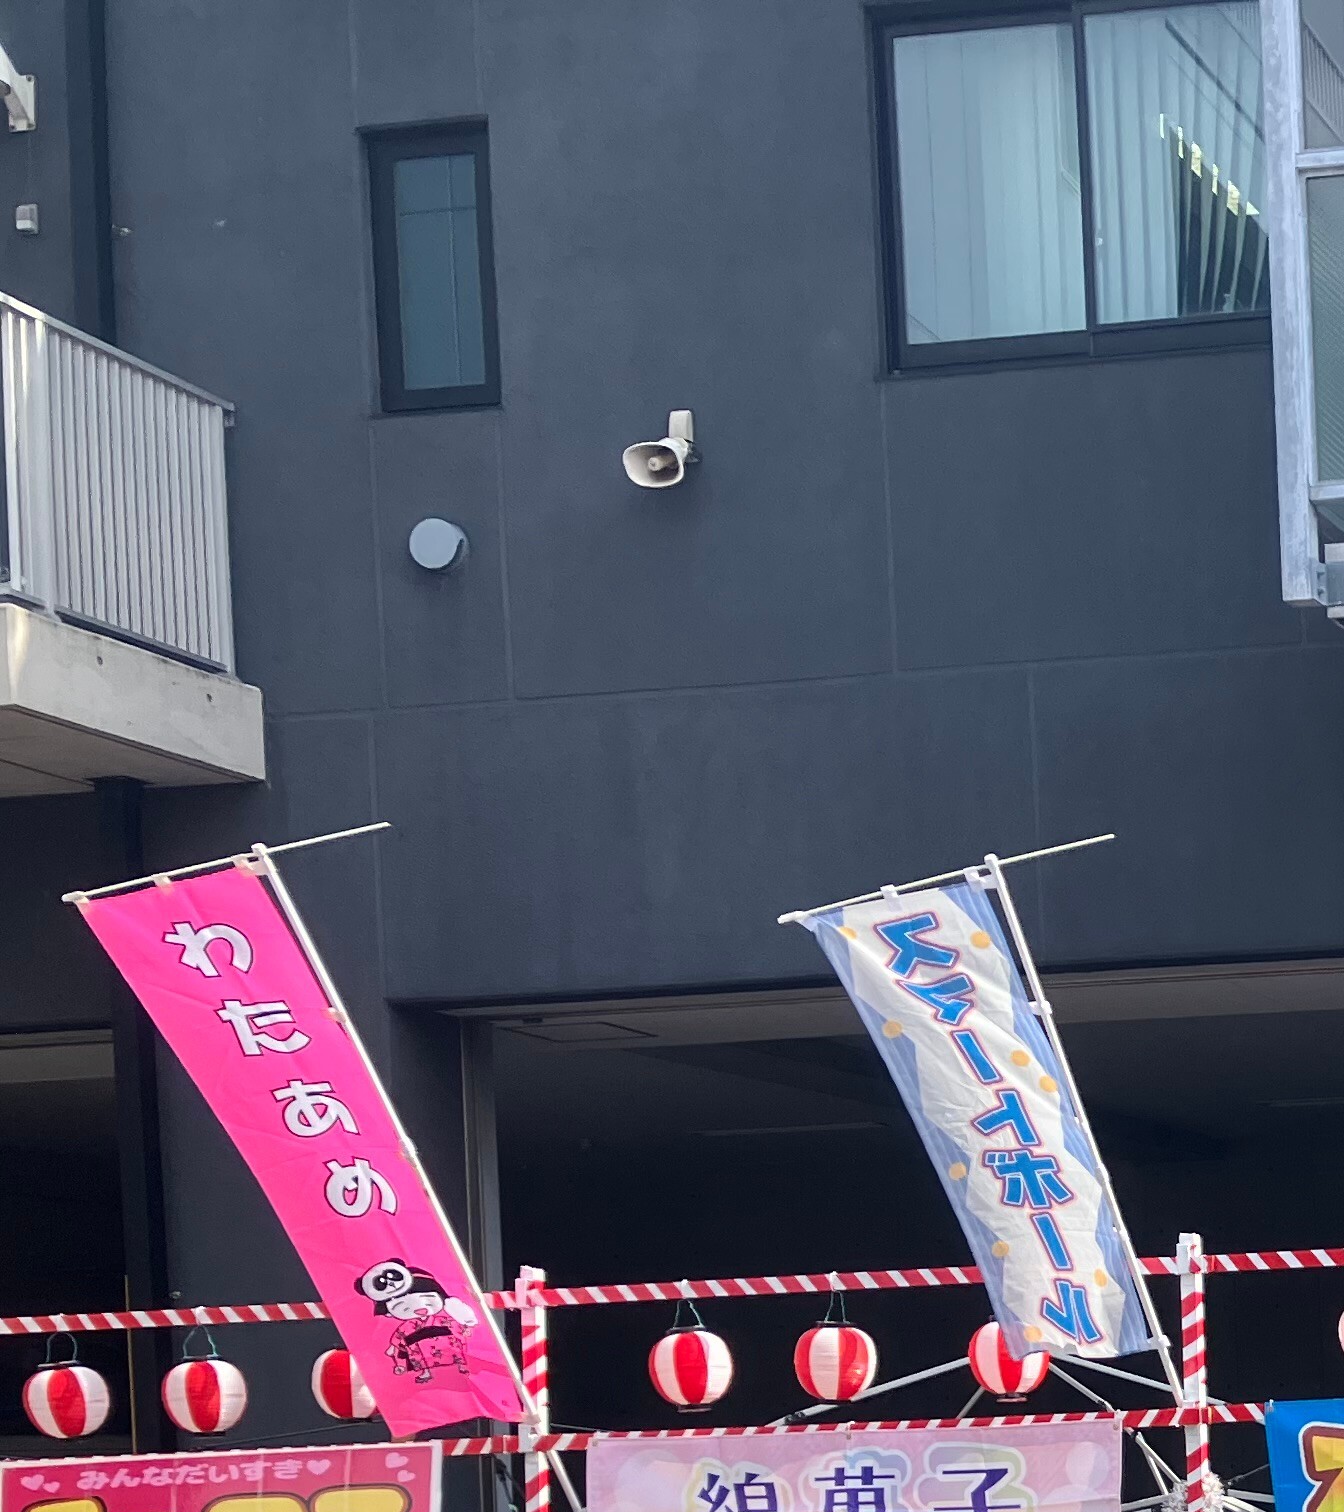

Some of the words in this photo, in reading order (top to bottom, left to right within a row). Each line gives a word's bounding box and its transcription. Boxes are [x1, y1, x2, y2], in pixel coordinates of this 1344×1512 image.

[162, 921, 398, 1218] わたあめ
[76, 1460, 304, 1490] みんなだいすき
